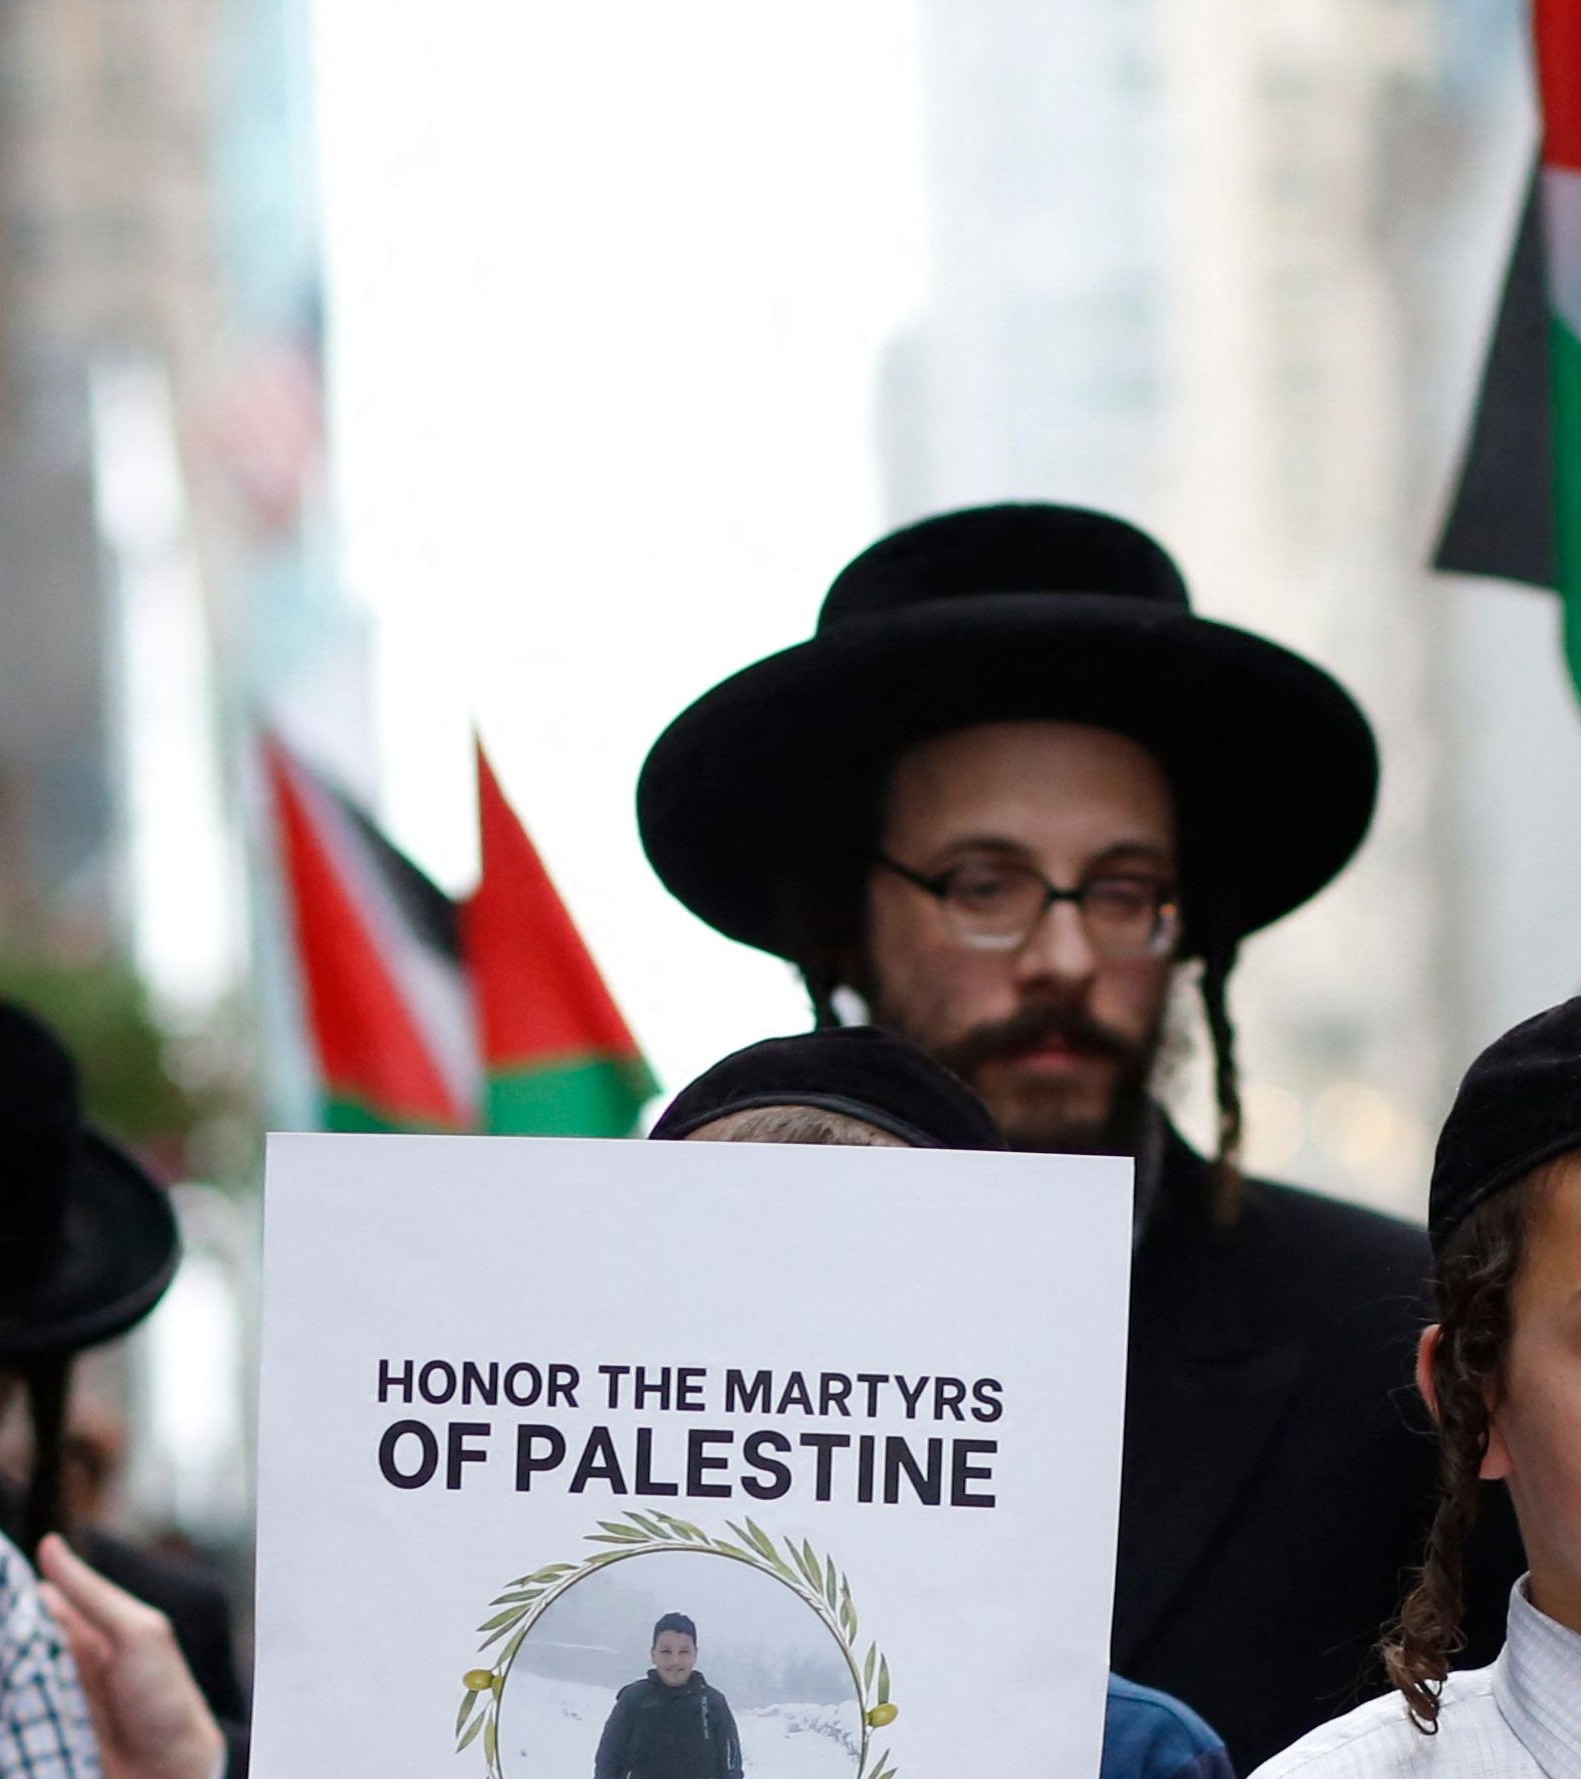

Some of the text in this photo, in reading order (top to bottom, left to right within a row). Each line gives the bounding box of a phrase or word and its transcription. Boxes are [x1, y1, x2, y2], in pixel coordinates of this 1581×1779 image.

[377, 1358, 1004, 1423] HONOR THE MARTYRS
[378, 1419, 998, 1509] OF PALESTINE
